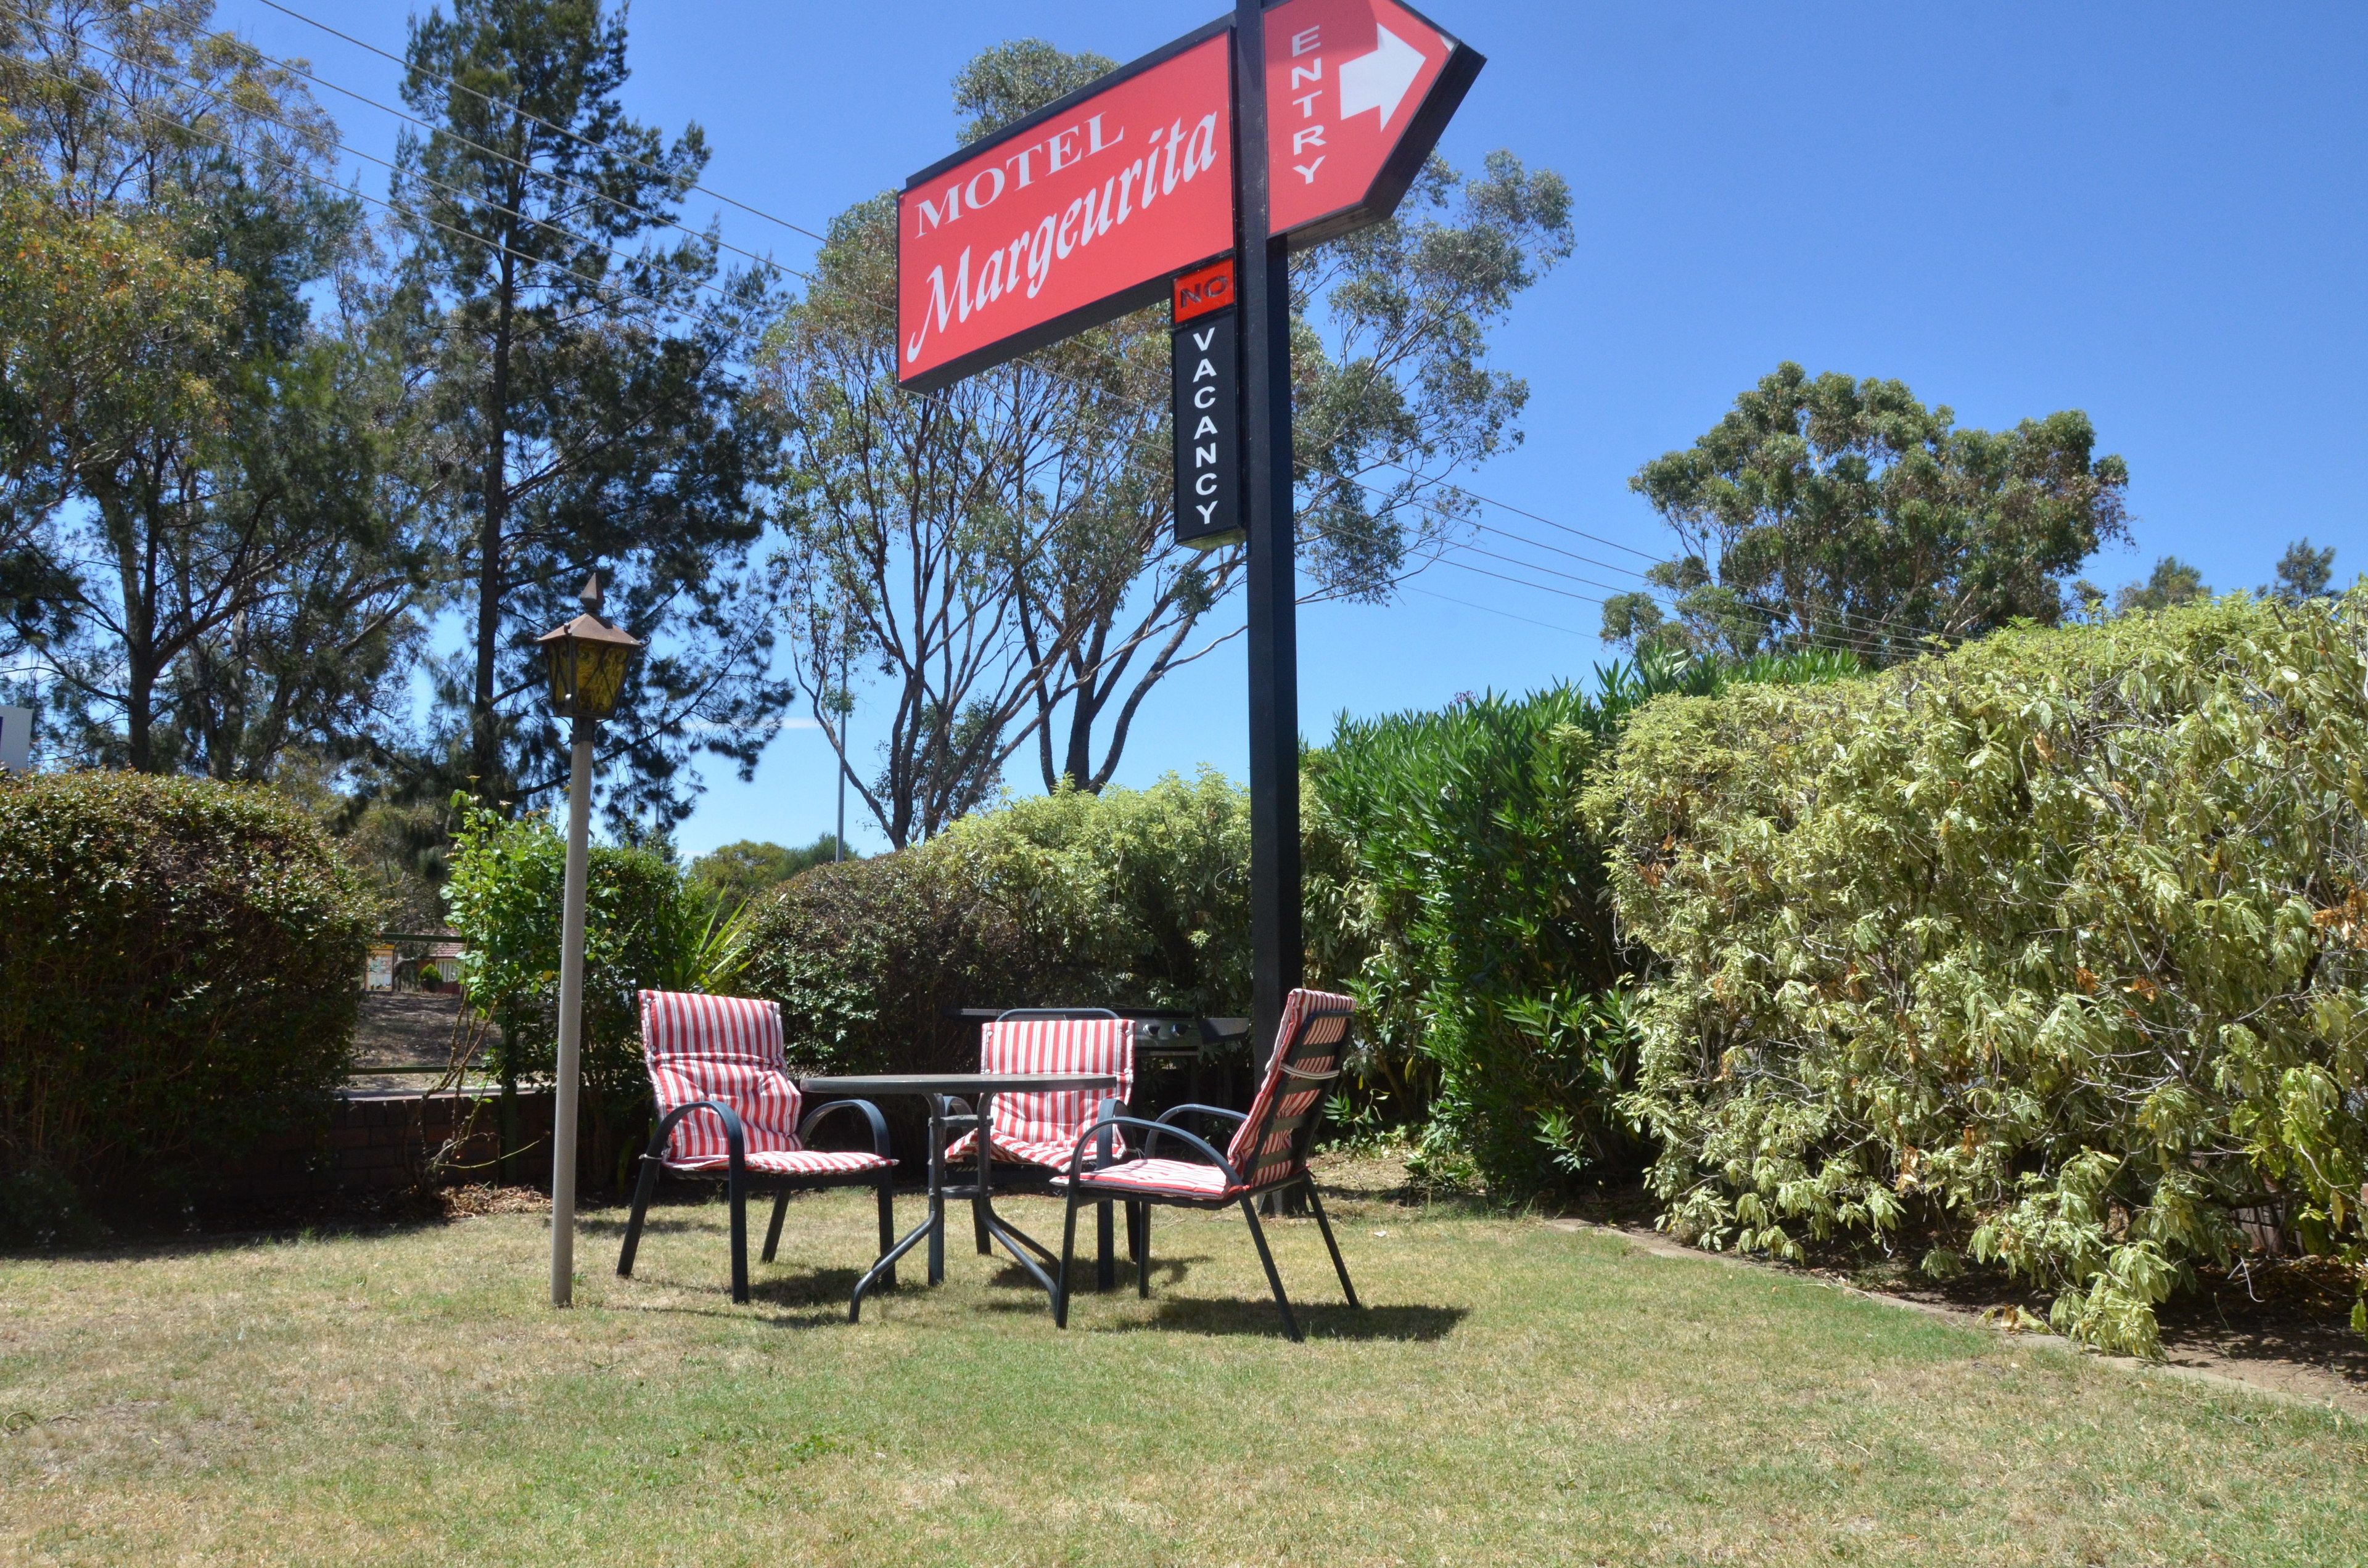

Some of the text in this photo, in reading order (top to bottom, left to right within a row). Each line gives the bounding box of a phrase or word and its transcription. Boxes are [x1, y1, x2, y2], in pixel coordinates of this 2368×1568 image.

[915, 111, 1124, 239] MOTEL
[1291, 25, 1326, 184] ENTRY
[906, 110, 1217, 363] Margeurita
[1180, 275, 1228, 308] NO
[1192, 327, 1218, 525] VACANCY
